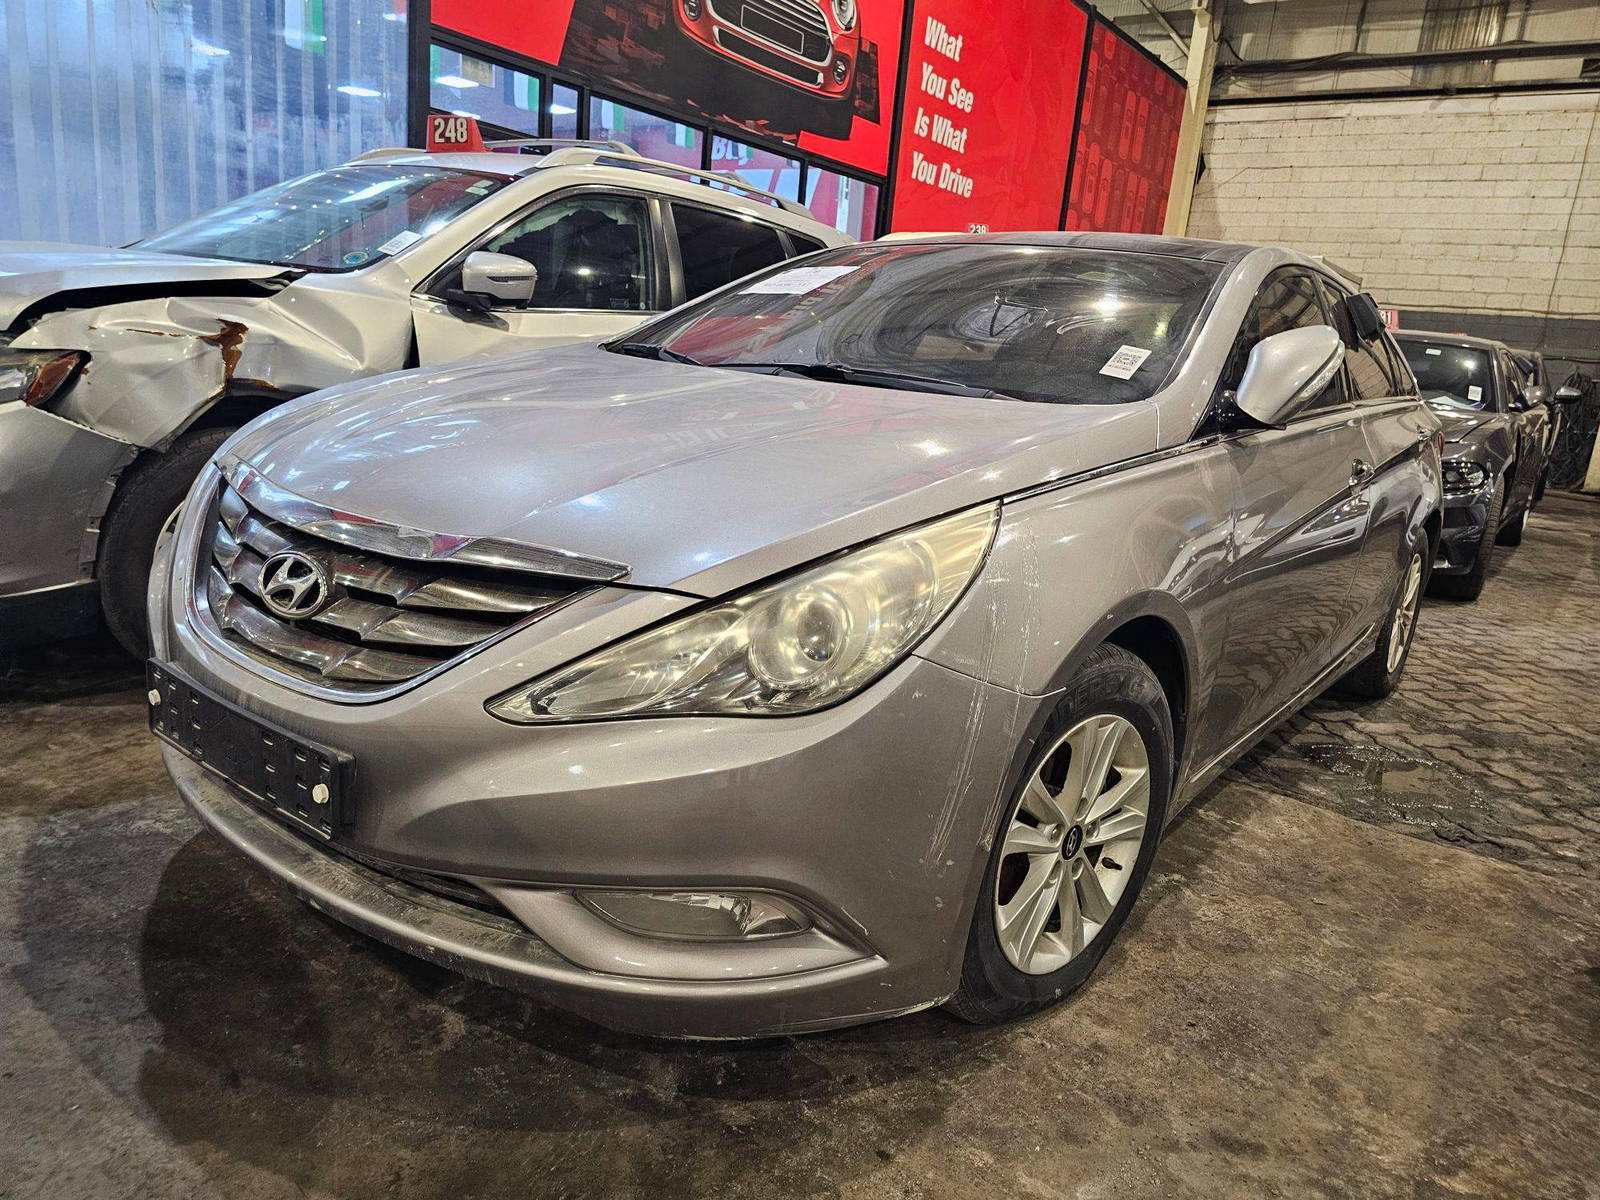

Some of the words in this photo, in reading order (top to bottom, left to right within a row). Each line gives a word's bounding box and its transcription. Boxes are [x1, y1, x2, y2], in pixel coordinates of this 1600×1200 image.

[924, 16, 963, 63] What
[920, 61, 948, 100] You
[948, 78, 974, 113] See
[434, 118, 468, 143] 248
[914, 106, 930, 138] Is
[931, 114, 968, 154] What
[911, 151, 938, 186] You
[938, 162, 974, 199] Drive
